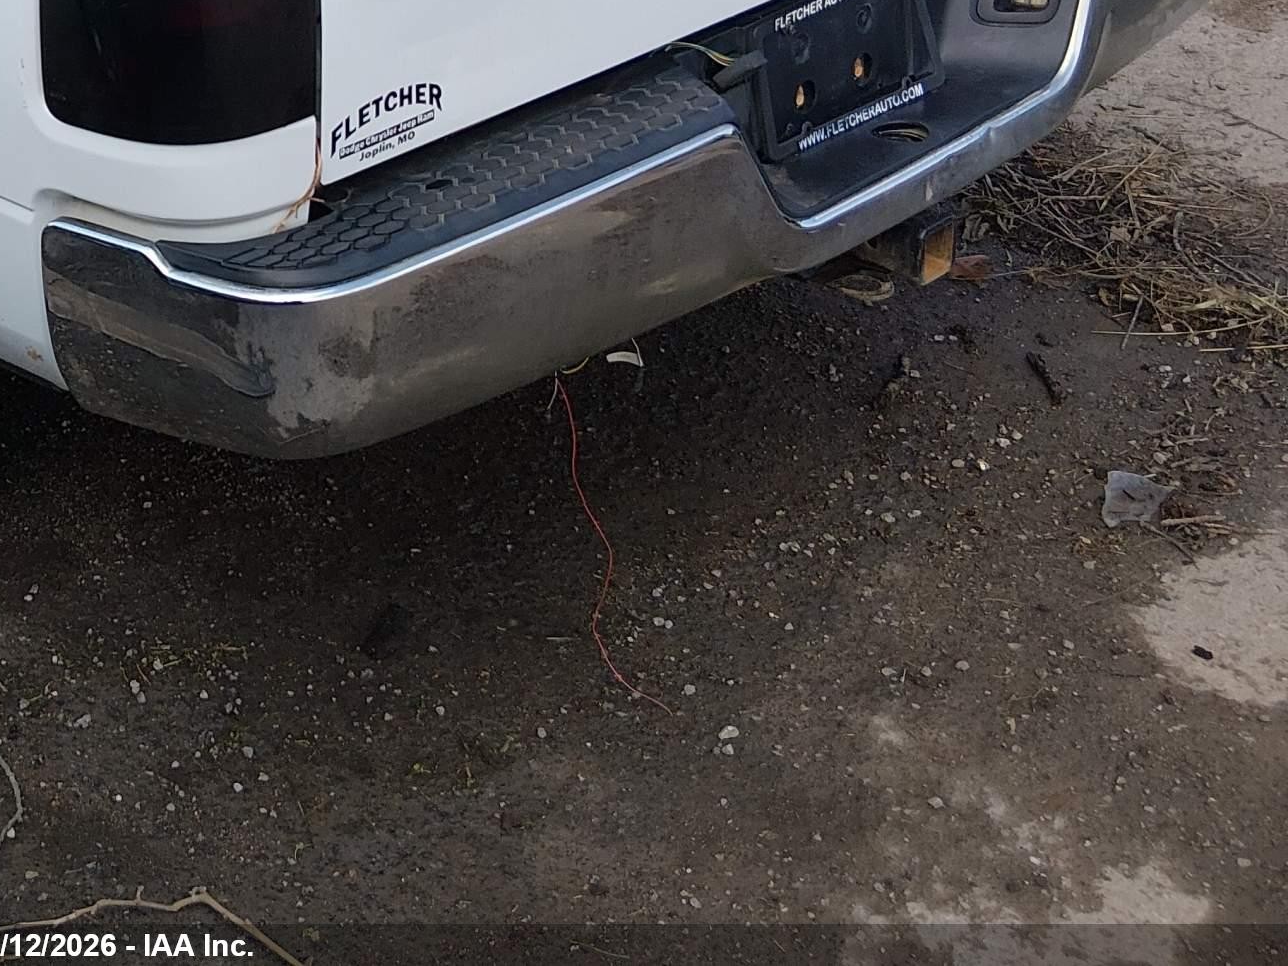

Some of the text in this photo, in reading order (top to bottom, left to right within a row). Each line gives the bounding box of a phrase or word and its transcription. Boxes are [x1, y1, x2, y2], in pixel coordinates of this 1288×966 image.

[774, 0, 823, 32] FLETCHER
[330, 82, 443, 158] FLETCHER
[798, 83, 924, 150] WWW.FLETCHERAUTO.COM
[360, 131, 415, 161] Joplin, MO
